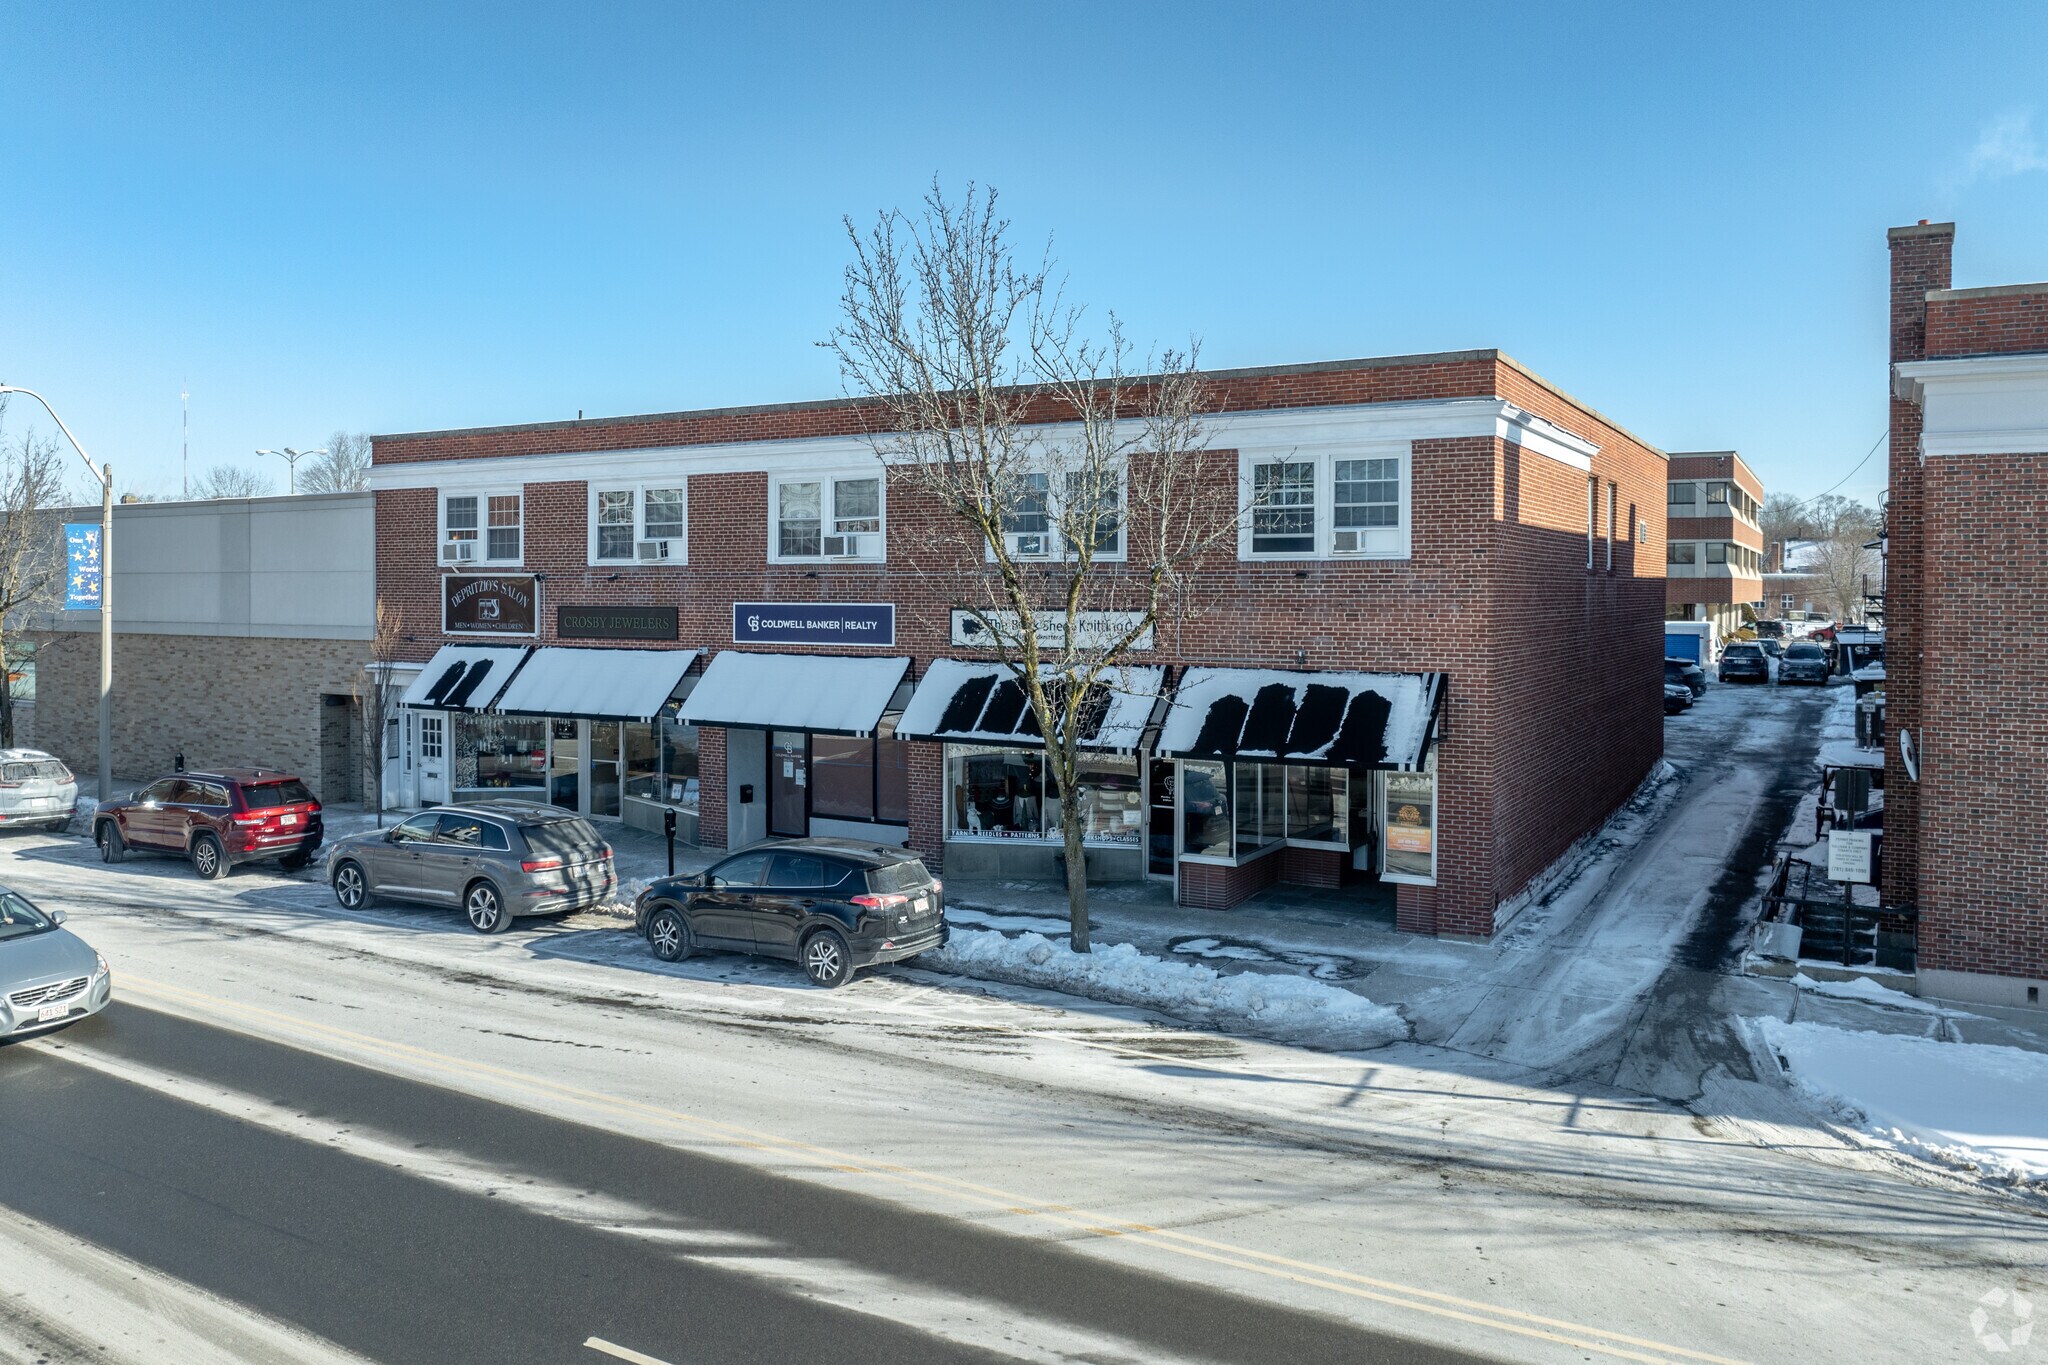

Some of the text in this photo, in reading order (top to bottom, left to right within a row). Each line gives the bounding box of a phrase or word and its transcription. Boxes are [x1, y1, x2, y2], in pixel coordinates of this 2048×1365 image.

[69, 594, 99, 602] Together
[451, 579, 530, 608] DEPRITZIO'S SALON
[564, 616, 670, 630] CROSBY JEWELERS
[761, 619, 878, 630] COLDWELL BANKER REALTY
